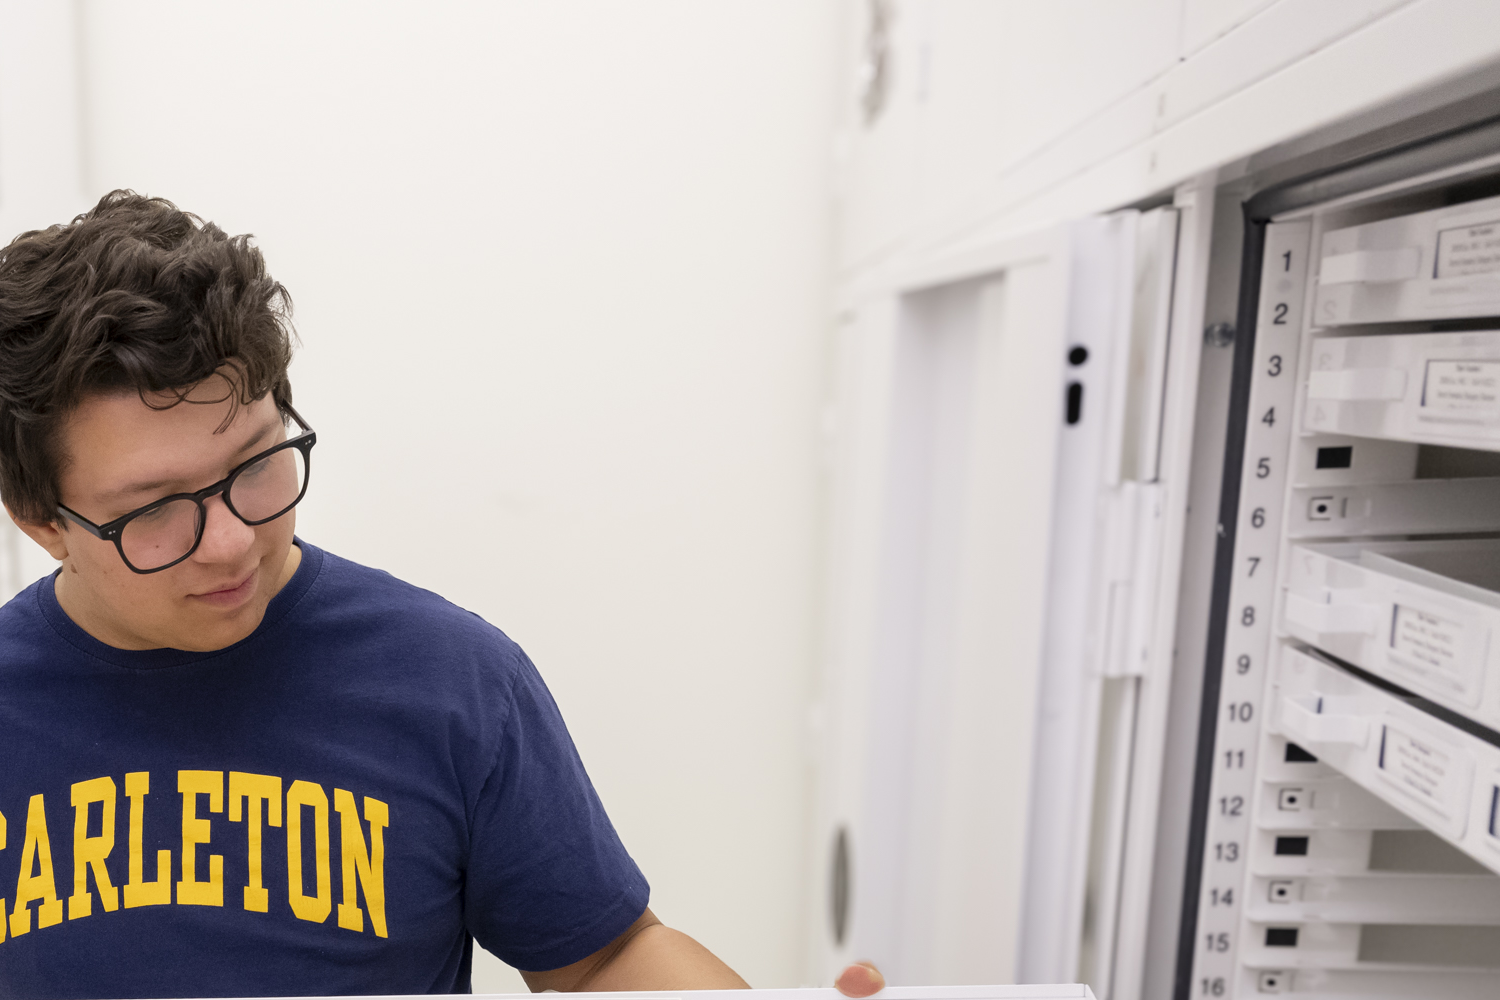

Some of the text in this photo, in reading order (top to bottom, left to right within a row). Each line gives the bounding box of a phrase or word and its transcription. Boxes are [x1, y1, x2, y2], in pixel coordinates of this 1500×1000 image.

[1281, 250, 1292, 272] 1
[1273, 303, 1288, 325] 2
[1267, 355, 1282, 377] 3
[1261, 406, 1276, 428] 4
[1256, 457, 1271, 479] 5
[1251, 507, 1265, 529] 6
[1246, 557, 1261, 577] 7
[1240, 605, 1255, 627] 8
[1236, 654, 1251, 675] 9
[1227, 702, 1253, 723] 10
[1223, 750, 1245, 770] 11
[1218, 795, 1244, 817] 12
[1214, 842, 1239, 863] 13
[1209, 888, 1234, 907] 14
[1205, 933, 1230, 952] 15
[1200, 977, 1225, 997] 16
